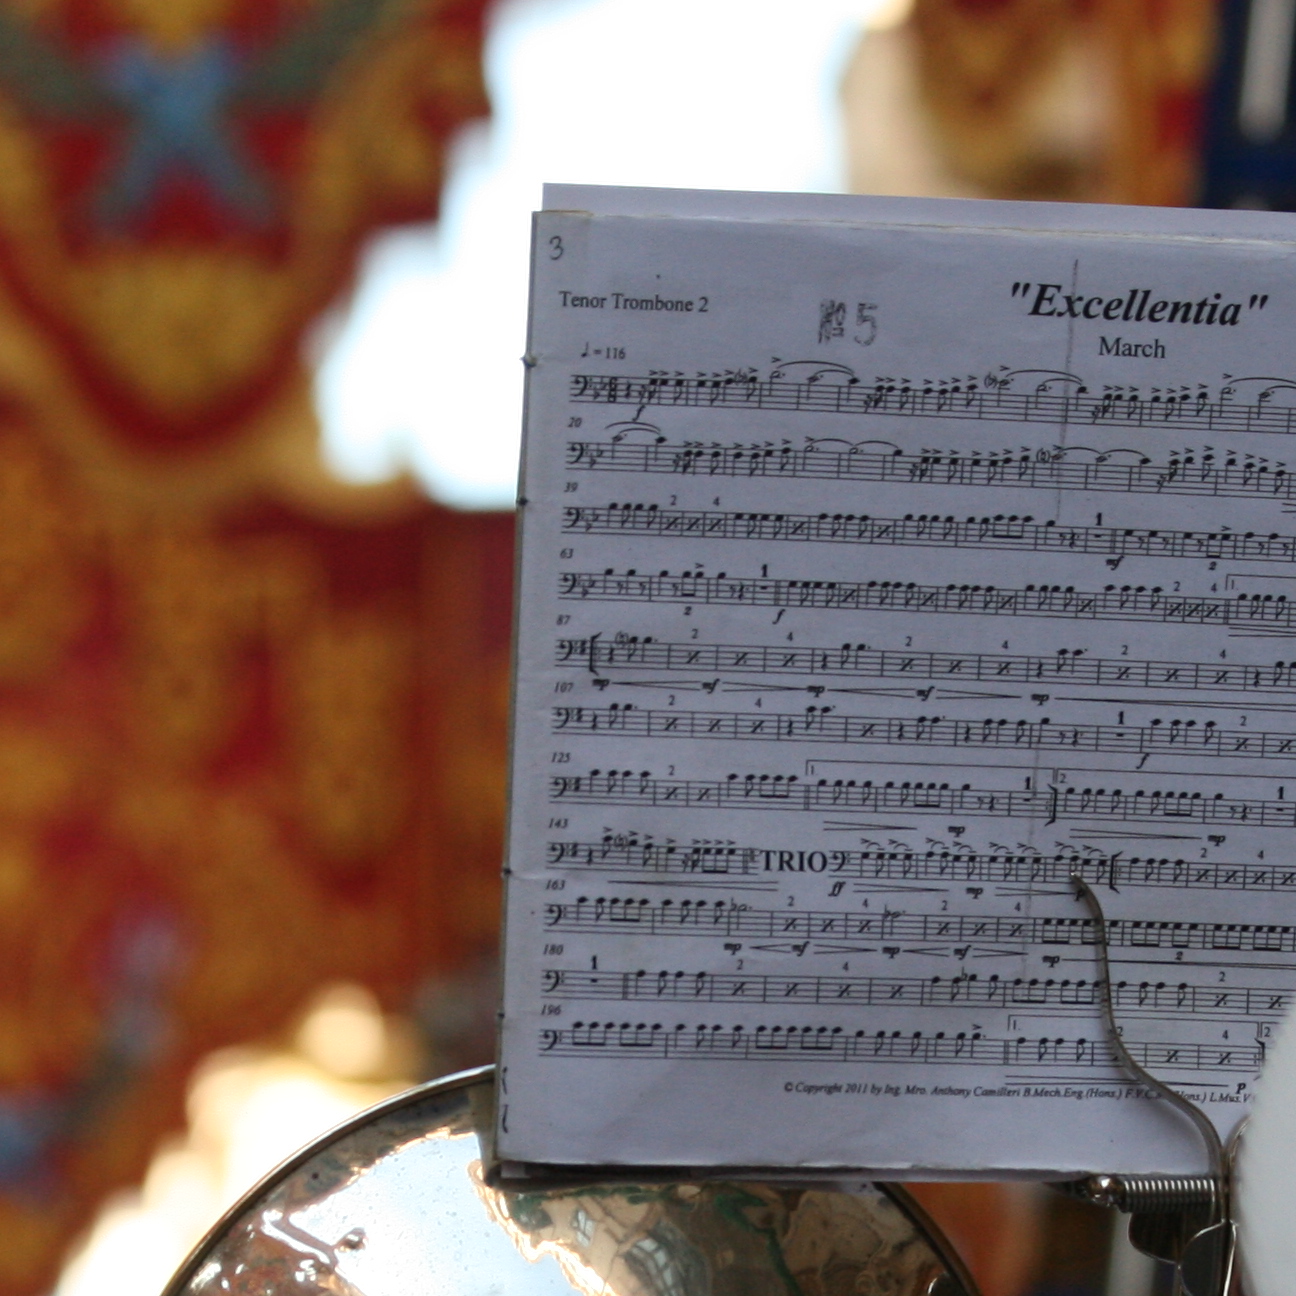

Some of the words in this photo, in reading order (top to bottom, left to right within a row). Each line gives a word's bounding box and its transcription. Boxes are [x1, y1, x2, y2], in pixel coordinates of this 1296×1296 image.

[549, 235, 565, 260] 3
[558, 290, 607, 309] Tenor
[611, 292, 695, 313] Trombone
[698, 296, 709, 313] 2
[1011, 281, 1268, 326] "Excellentia"
[854, 302, 880, 347] 5
[605, 346, 627, 360] 116
[1098, 335, 1166, 359] March
[567, 417, 583, 429] 20
[563, 482, 579, 493] 39
[559, 548, 575, 560] 63
[555, 614, 572, 626] 87
[553, 681, 575, 694] 107
[551, 751, 571, 764] 125
[548, 817, 569, 829] 143
[760, 849, 828, 873] TRIO
[545, 879, 566, 891] 163
[543, 944, 564, 956] 180
[540, 1004, 562, 1016] 196
[796, 1081, 843, 1096] Copyright
[845, 1083, 868, 1094] 2011
[871, 1084, 883, 1096] by
[930, 1086, 972, 1099] Anthony
[973, 1086, 1021, 1097] Camilleri
